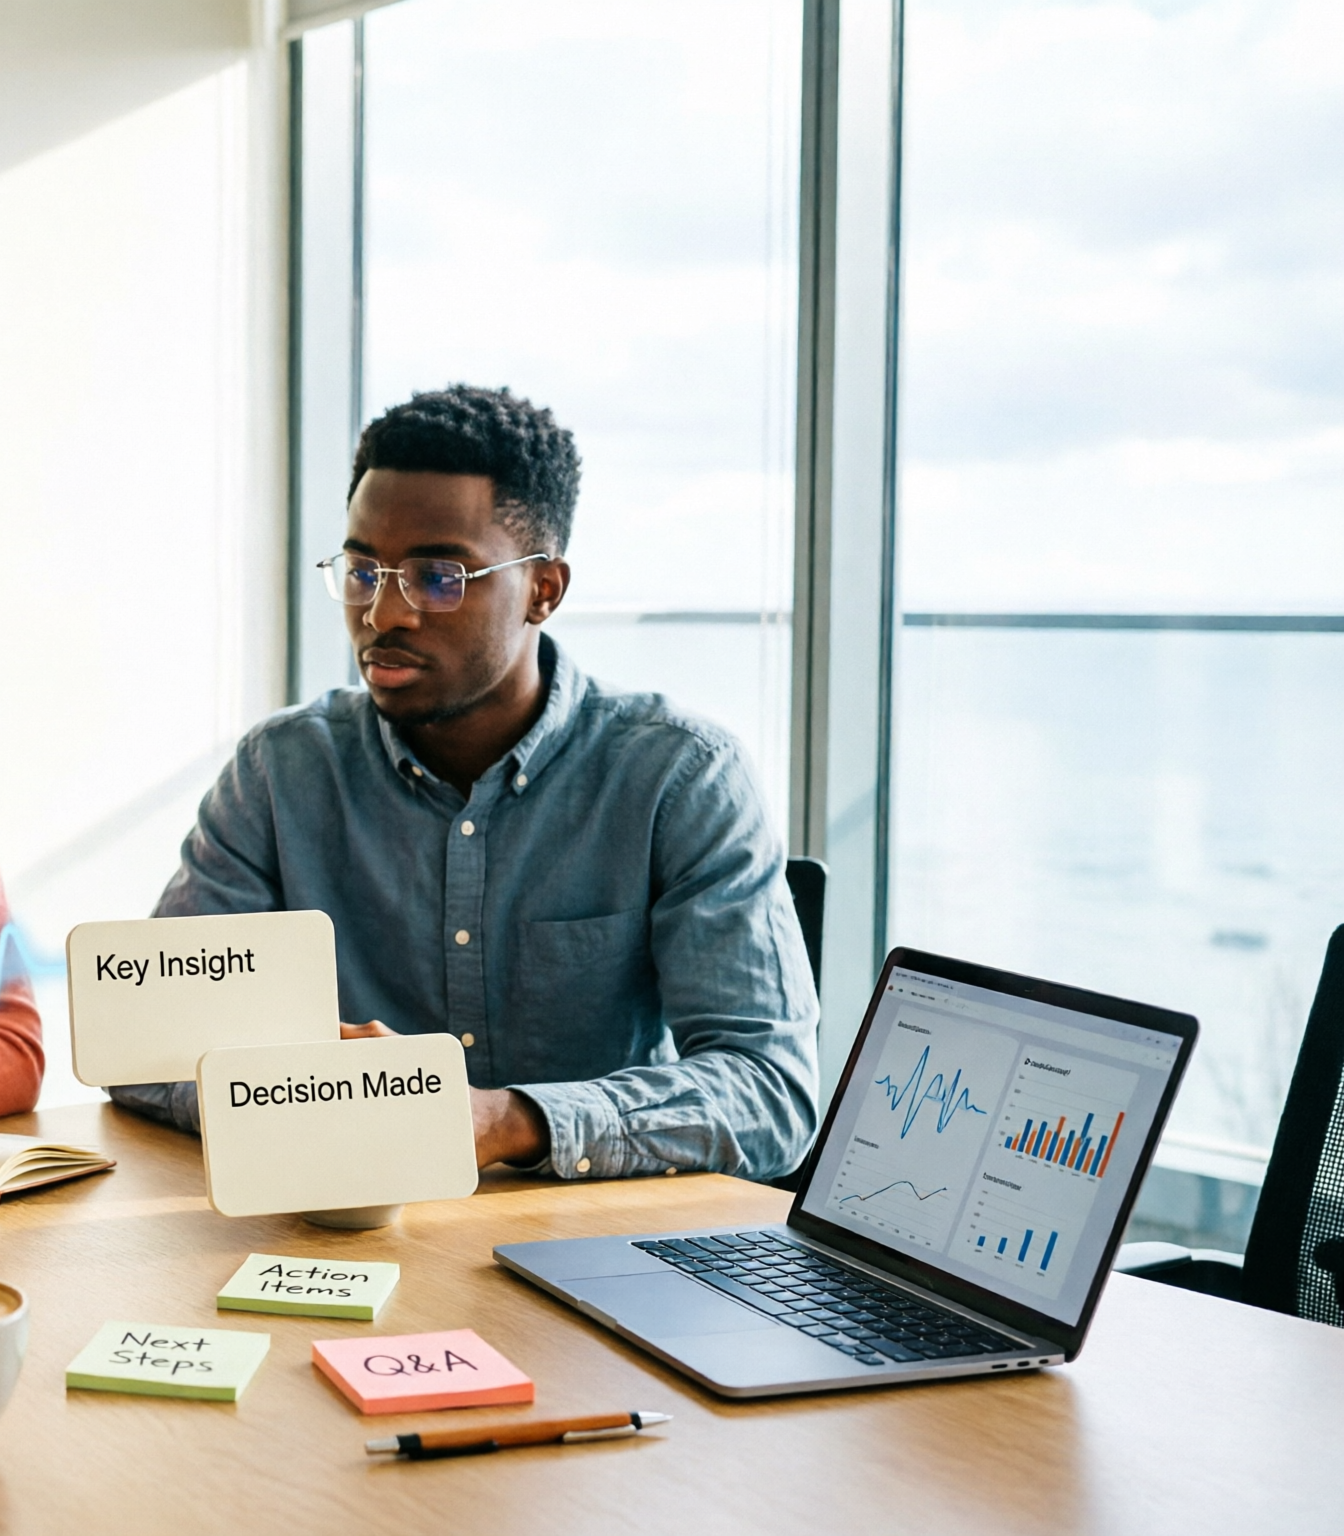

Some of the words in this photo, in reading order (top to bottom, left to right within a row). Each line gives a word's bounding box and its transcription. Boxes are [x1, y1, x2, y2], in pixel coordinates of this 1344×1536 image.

[96, 953, 150, 987] Key
[159, 946, 256, 982] Insight
[229, 1075, 353, 1108] Decision
[362, 1067, 442, 1099] Made
[259, 1263, 369, 1284] Action
[260, 1280, 353, 1298] Items
[121, 1331, 211, 1352] Next
[109, 1350, 214, 1376] Steps
[363, 1350, 478, 1377] Q&A
